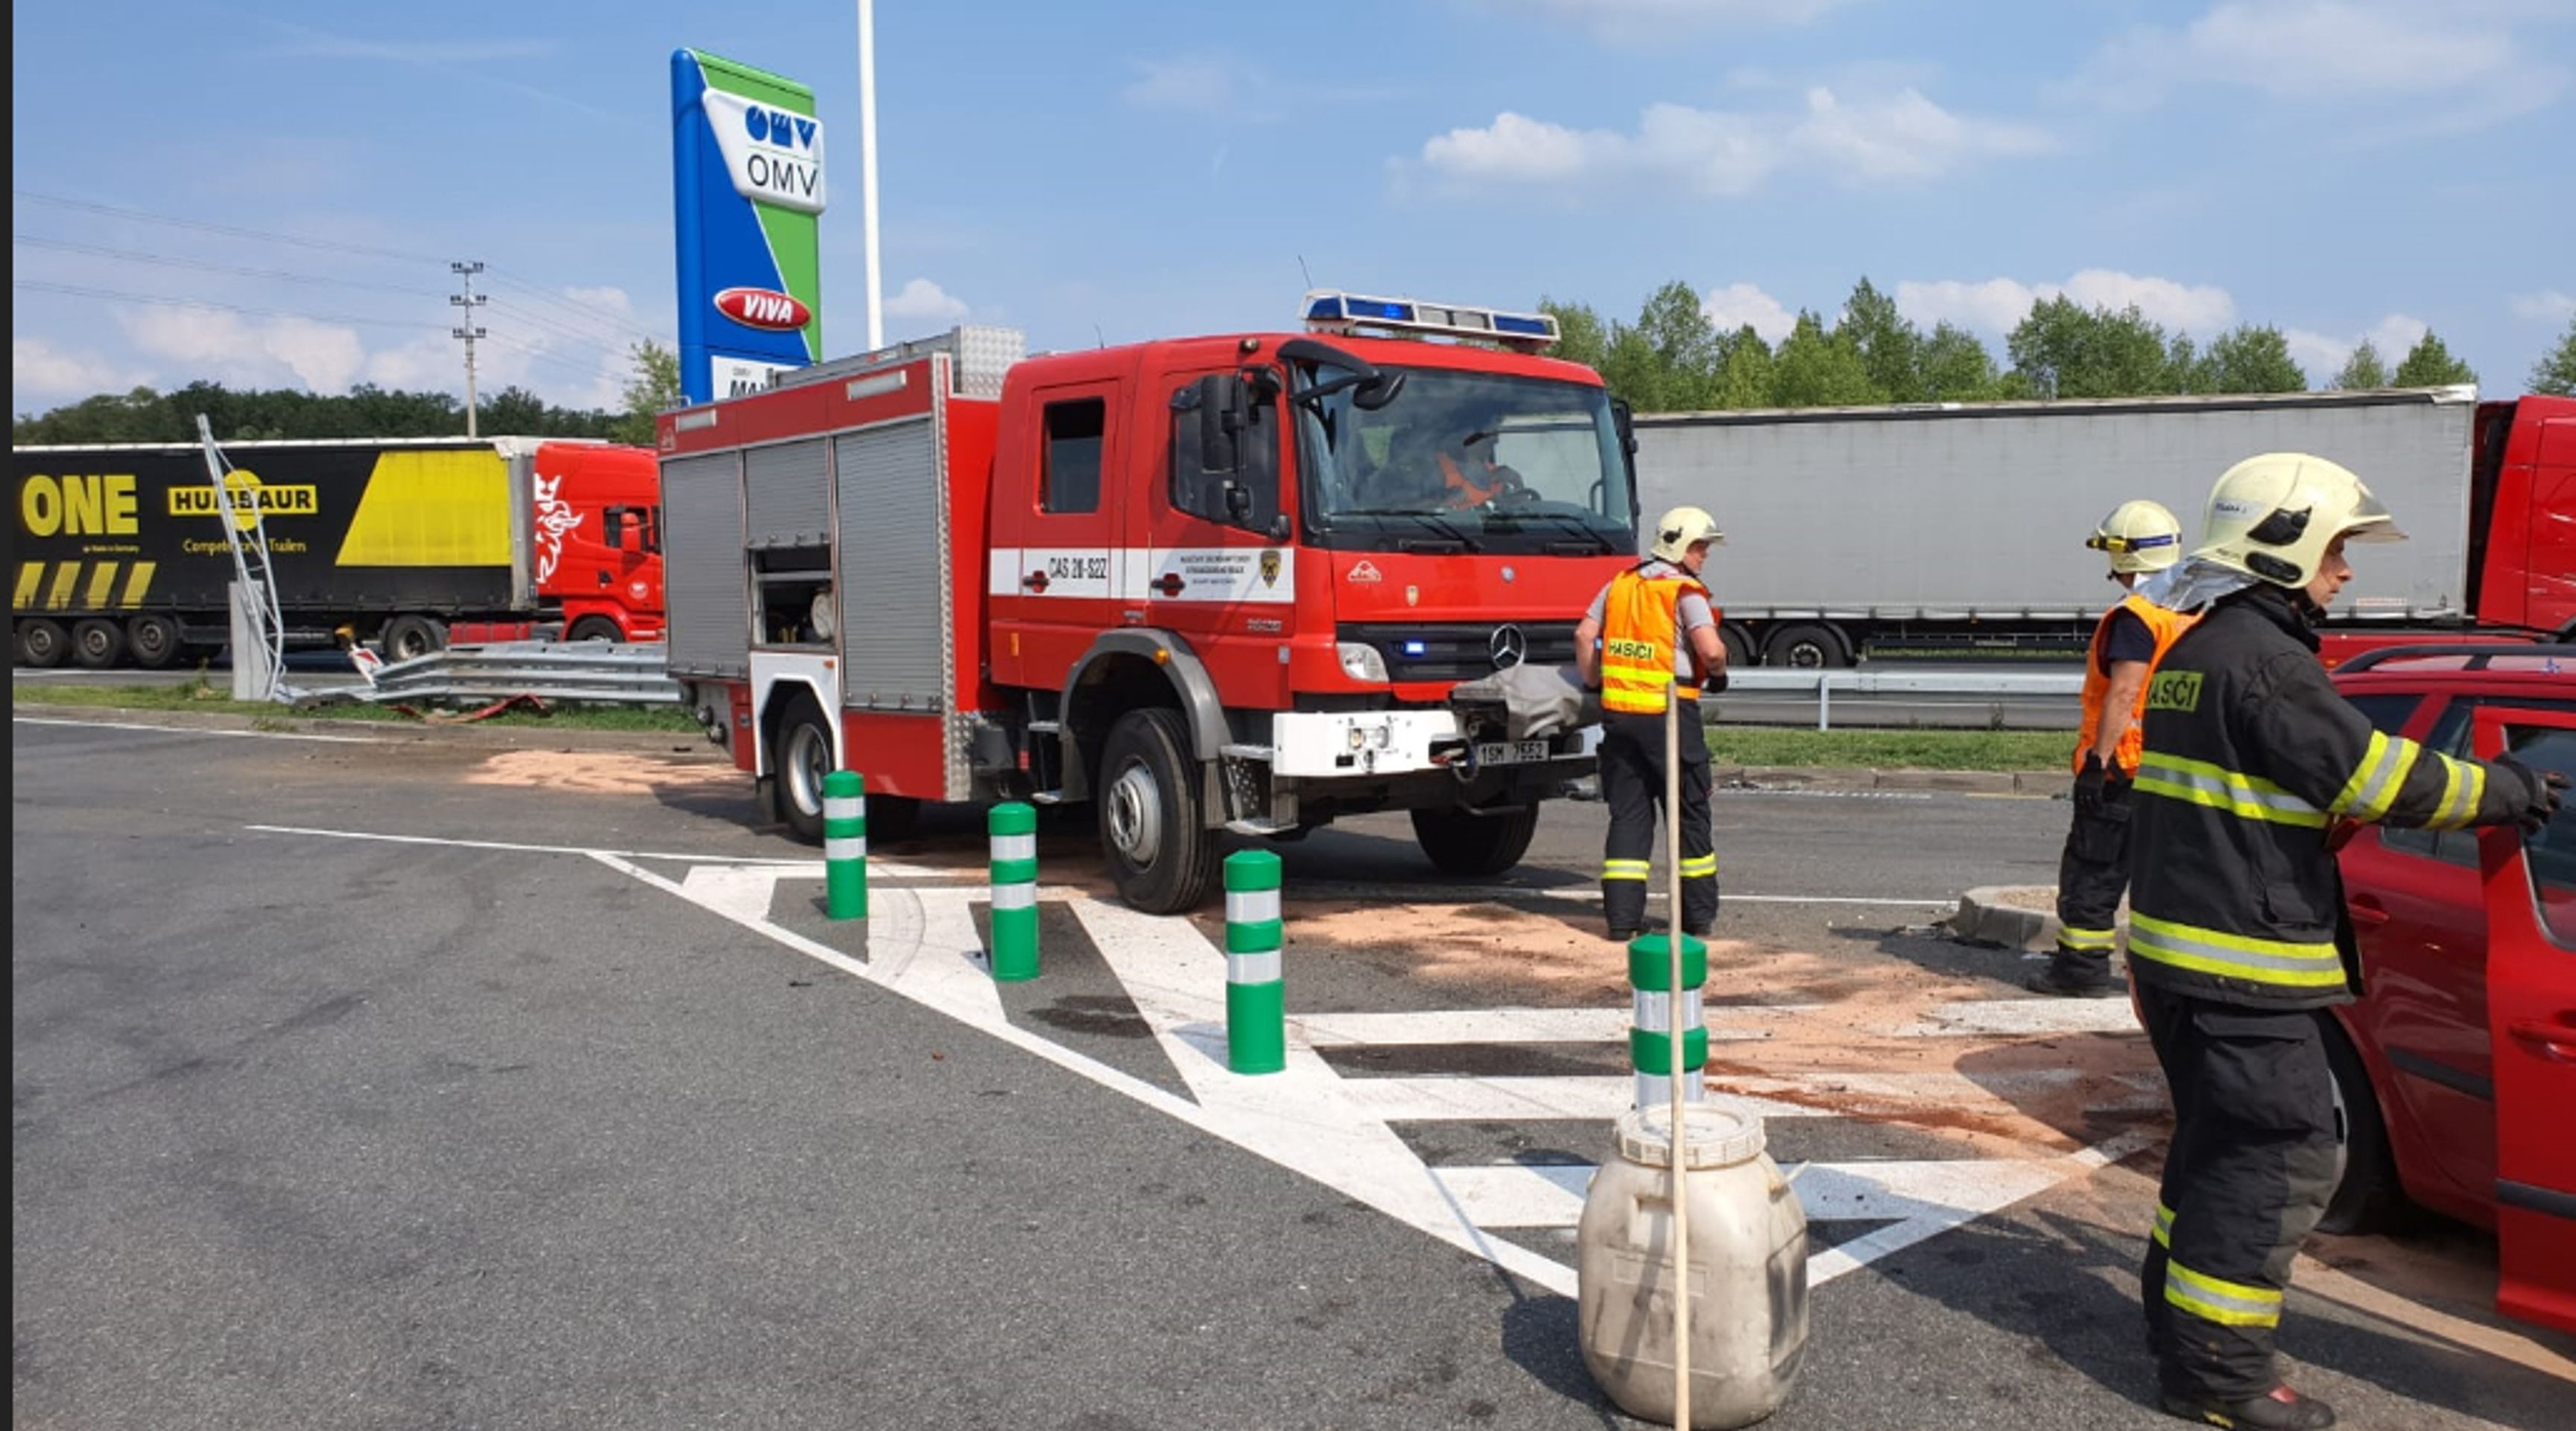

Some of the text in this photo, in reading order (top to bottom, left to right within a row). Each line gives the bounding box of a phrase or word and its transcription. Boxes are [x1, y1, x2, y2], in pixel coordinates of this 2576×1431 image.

[747, 154, 818, 196] OMV
[744, 294, 792, 323] VIVA
[22, 474, 139, 537] ONE
[1048, 557, 1069, 578] CAS
[1482, 742, 1543, 763] 1SM 7552
